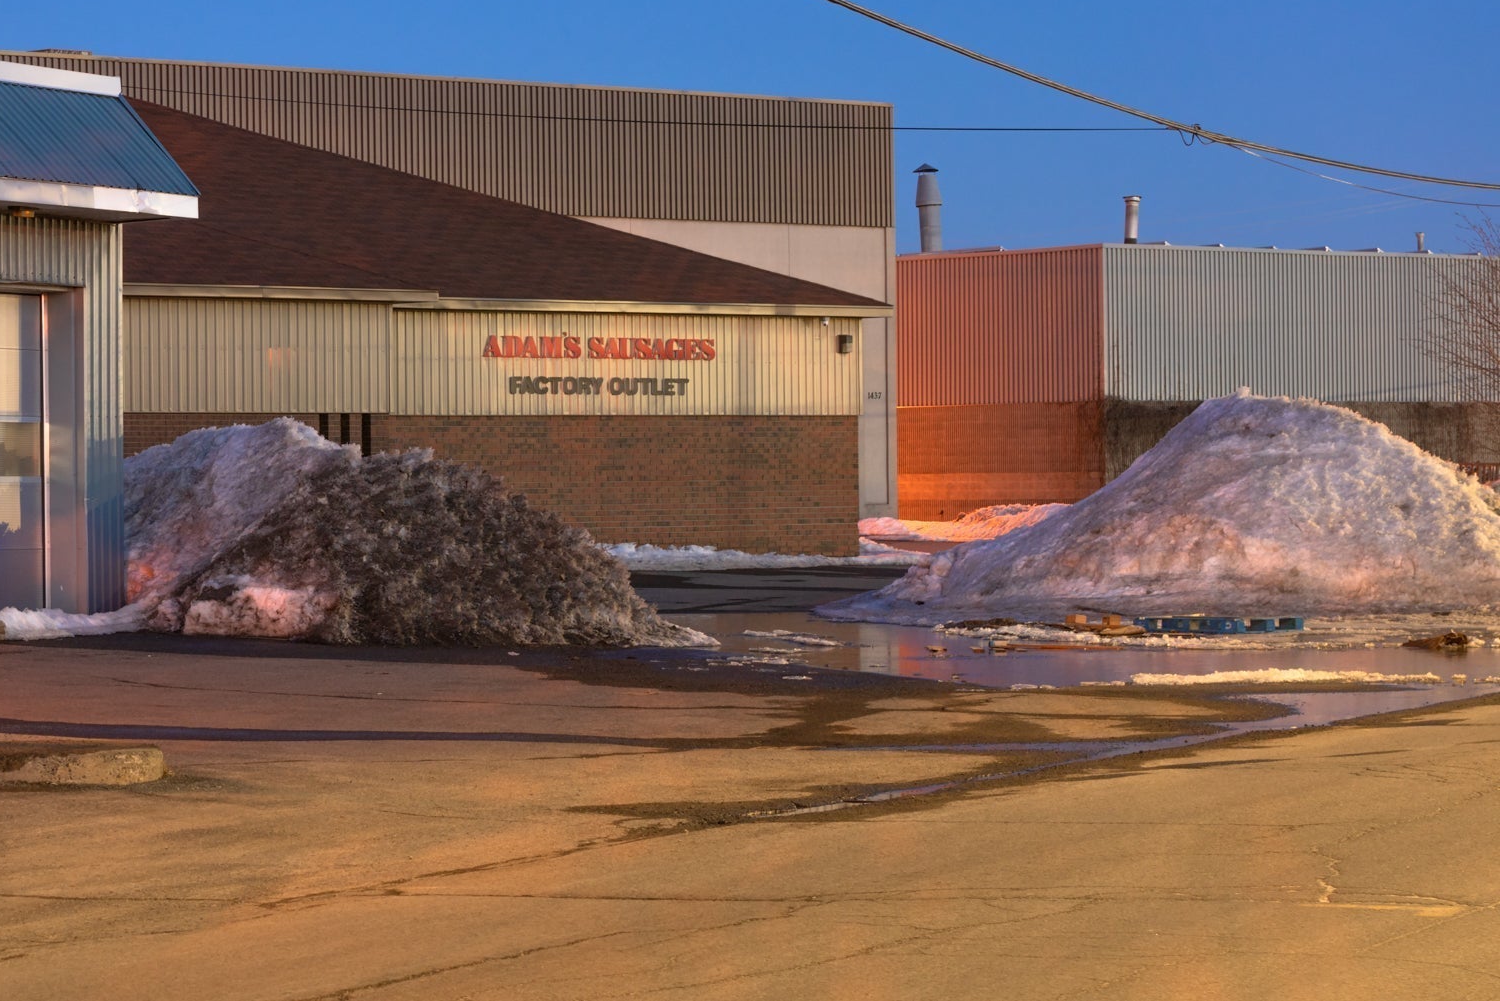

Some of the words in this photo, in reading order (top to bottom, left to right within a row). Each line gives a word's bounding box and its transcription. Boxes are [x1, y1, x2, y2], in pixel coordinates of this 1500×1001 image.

[482, 331, 582, 359] ADAM'S
[587, 336, 716, 361] SAUSAGES
[508, 376, 604, 395] FACTORY
[607, 377, 690, 396] OUTLET
[867, 391, 882, 400] 1437
